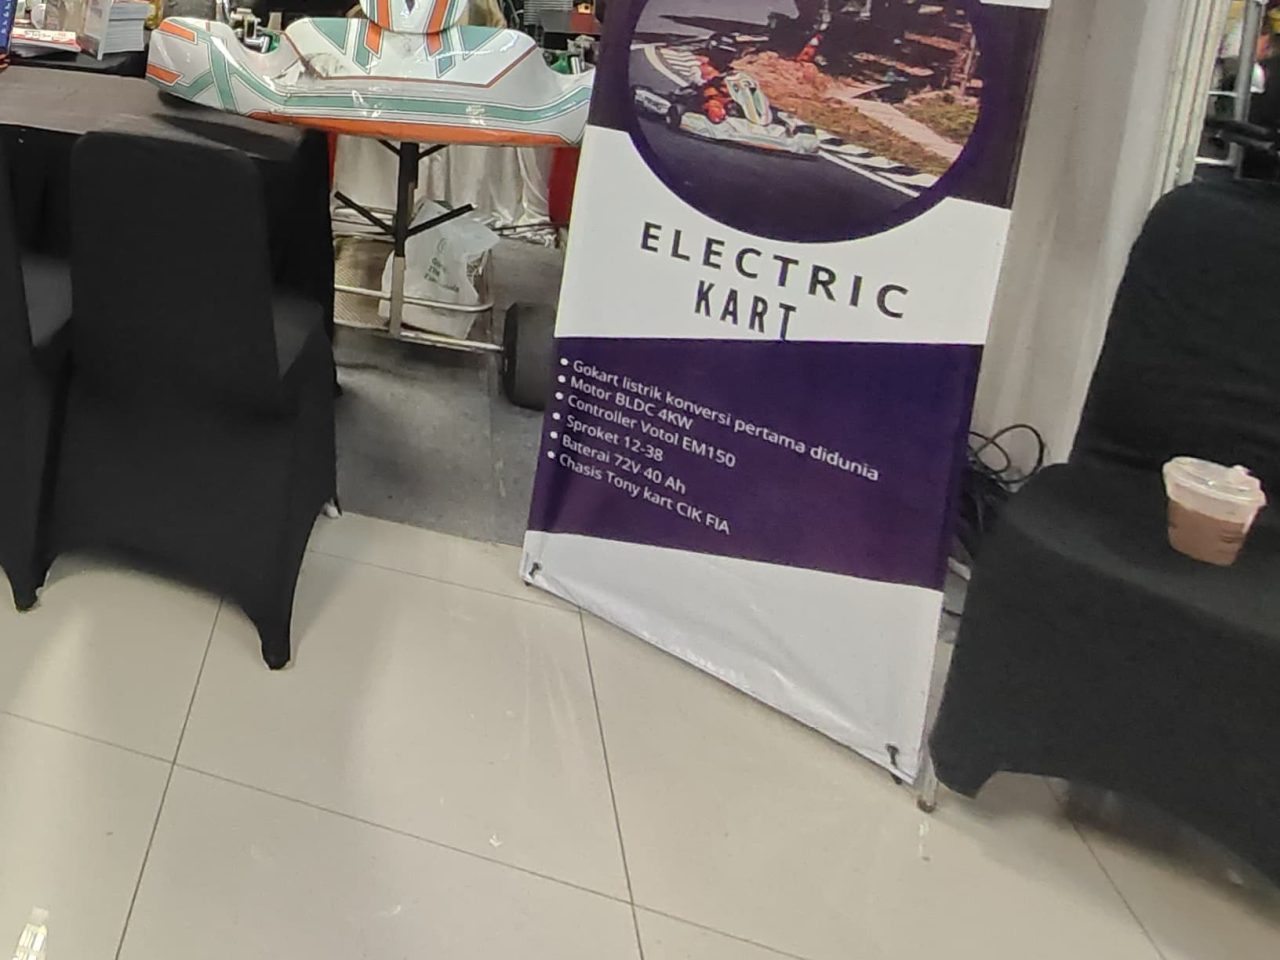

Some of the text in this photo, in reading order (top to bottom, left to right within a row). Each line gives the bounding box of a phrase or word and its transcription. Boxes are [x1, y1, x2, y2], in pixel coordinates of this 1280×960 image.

[641, 221, 908, 318] ELECTRIC
[695, 280, 797, 341] KART
[568, 395, 737, 468] Controller Votol EM150
[570, 376, 693, 430] Motor BLDC 4KW
[572, 359, 879, 481] Gokart listrik konversi pertama didunia
[562, 434, 687, 495] Baterai 72V 40 Ah
[566, 415, 664, 462] Sproket 12-38
[559, 452, 730, 535] Chasis Tony kart CIK FIA
